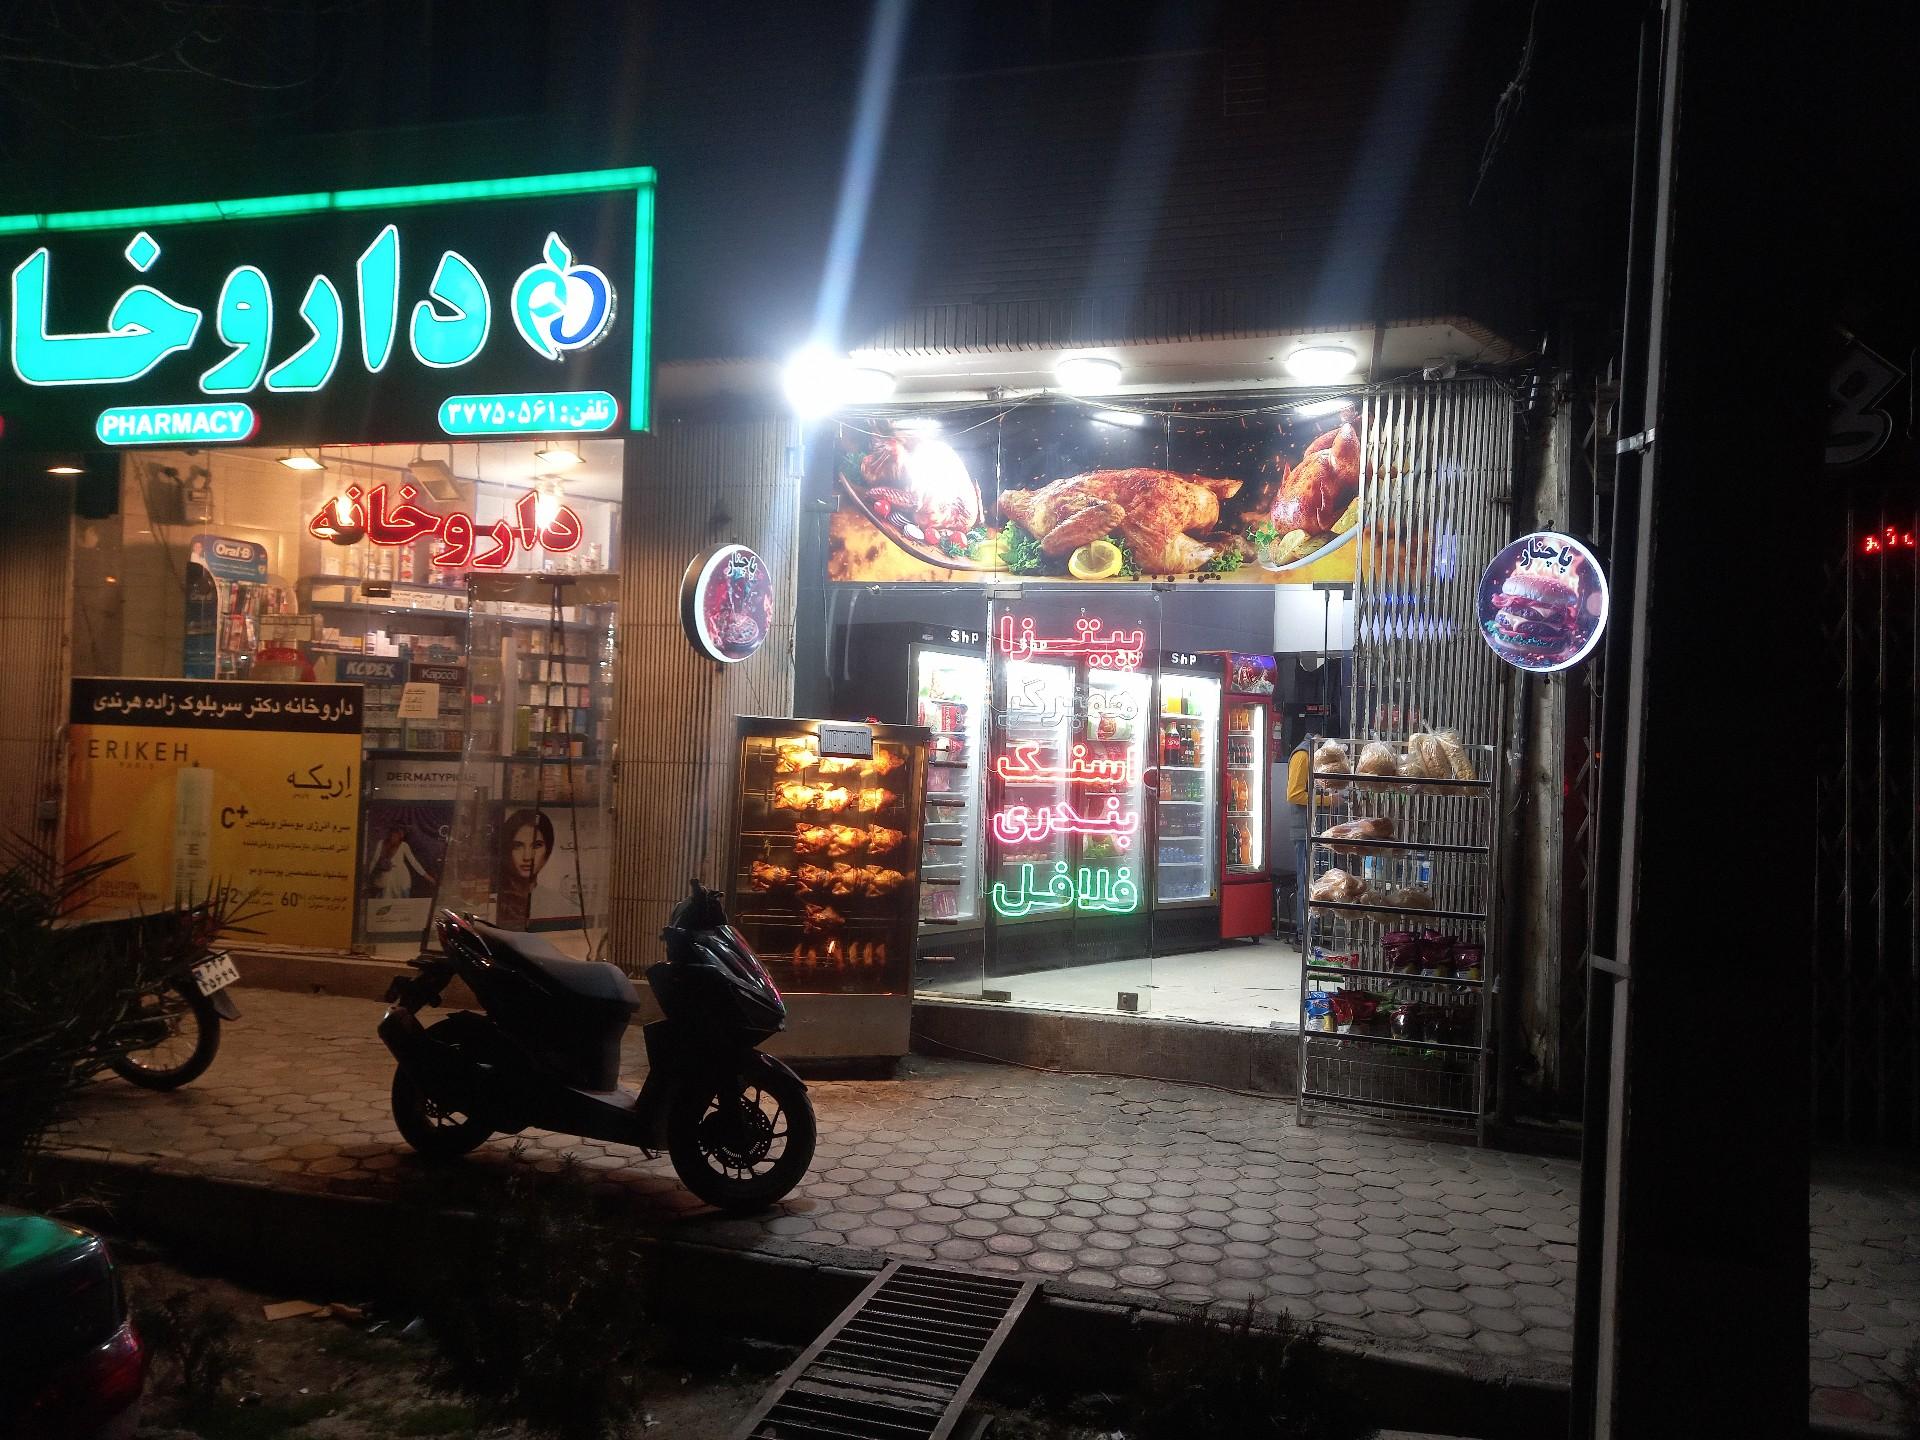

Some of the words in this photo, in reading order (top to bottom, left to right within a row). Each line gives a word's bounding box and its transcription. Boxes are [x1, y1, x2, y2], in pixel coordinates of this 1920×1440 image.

[102, 410, 245, 437] PHARMACY
[447, 399, 556, 425] ۳۷۷۵۰۵۶۱
[309, 484, 582, 569] داروخانه
[215, 543, 252, 559] Oral-B
[950, 629, 979, 644] Shp
[1000, 615, 1144, 672] پیتزا
[1171, 652, 1197, 665] Shp
[93, 691, 142, 715] هرندی
[145, 692, 174, 715] زاده
[245, 696, 280, 718] دکتر
[284, 695, 353, 721] داروخانه
[88, 739, 189, 763] ERIKEH
[997, 741, 1142, 783] اسنک
[994, 797, 1139, 848] بندری
[993, 861, 1138, 917] فلافل
